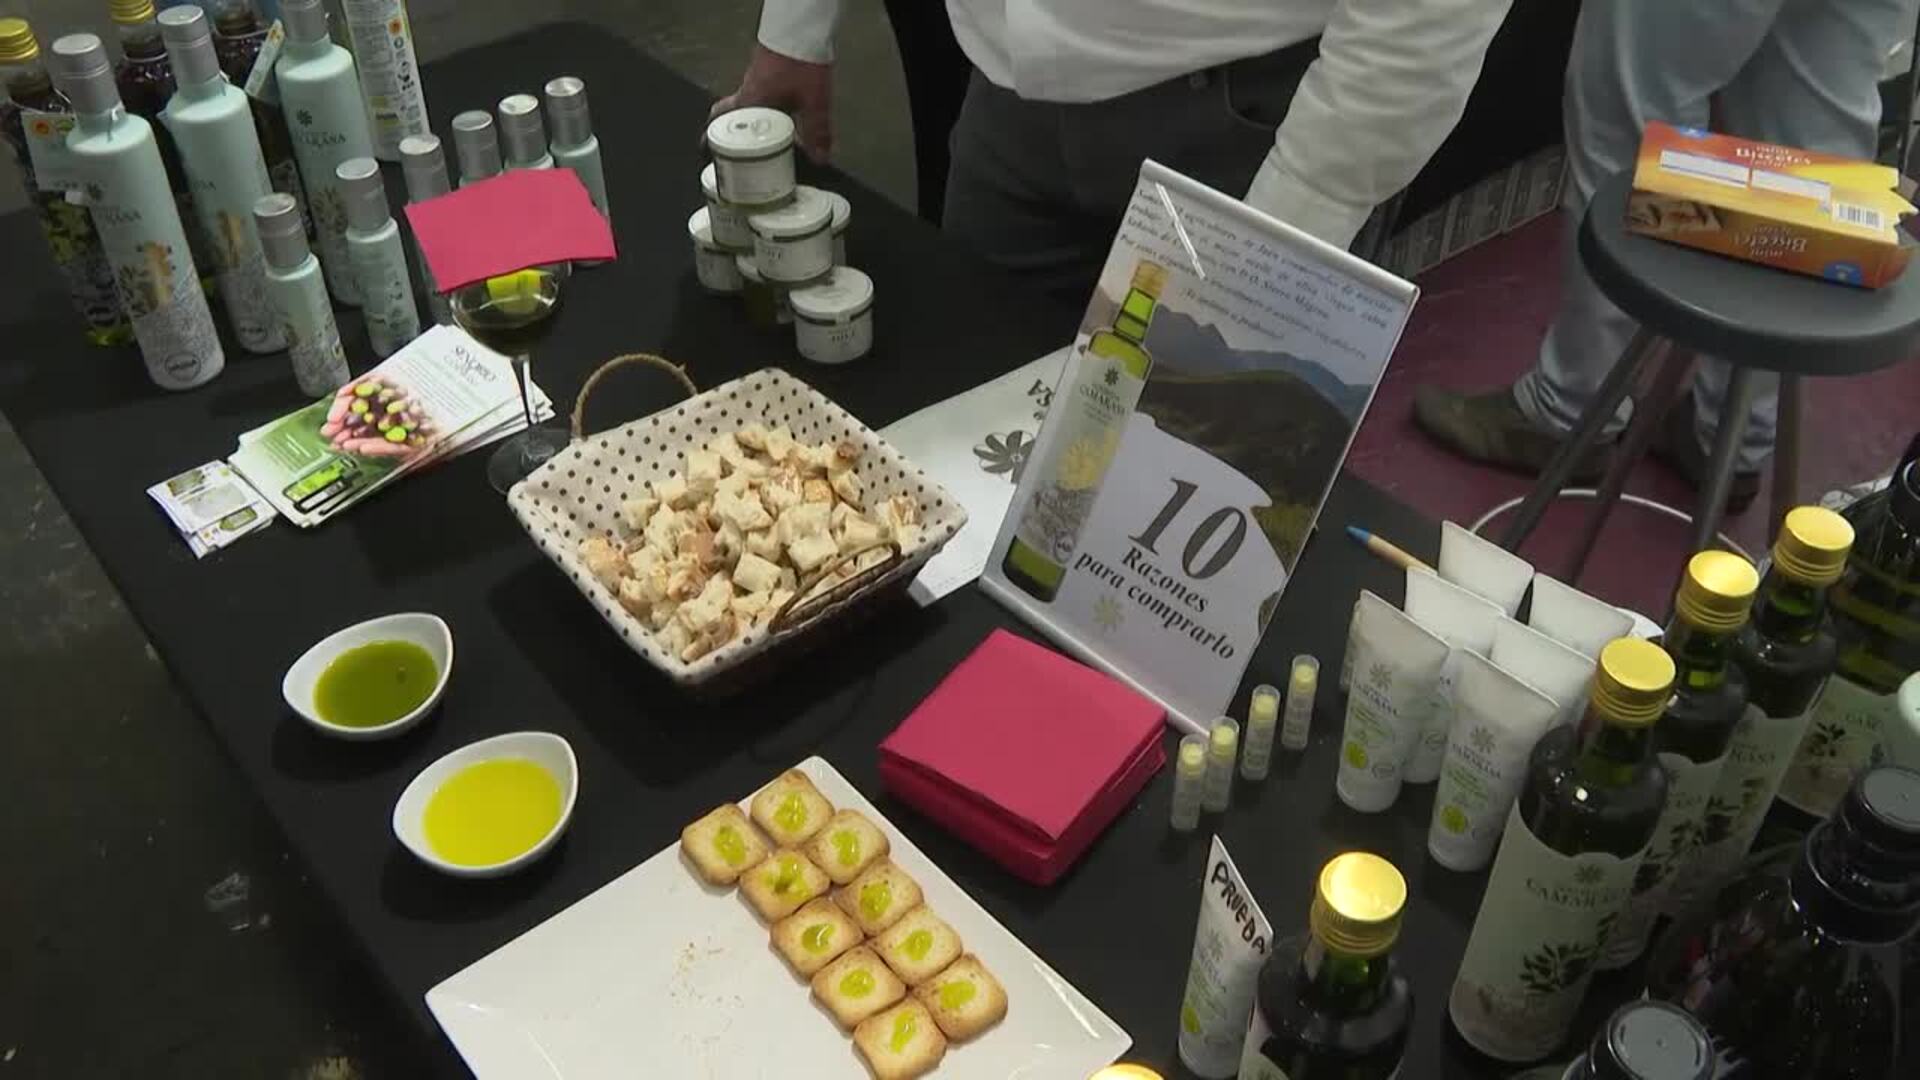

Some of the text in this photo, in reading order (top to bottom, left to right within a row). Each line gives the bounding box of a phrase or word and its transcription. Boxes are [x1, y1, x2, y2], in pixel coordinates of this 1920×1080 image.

[1121, 546, 1209, 614] Razones
[1127, 476, 1248, 580] 10
[1073, 552, 1235, 660] para comprarlo
